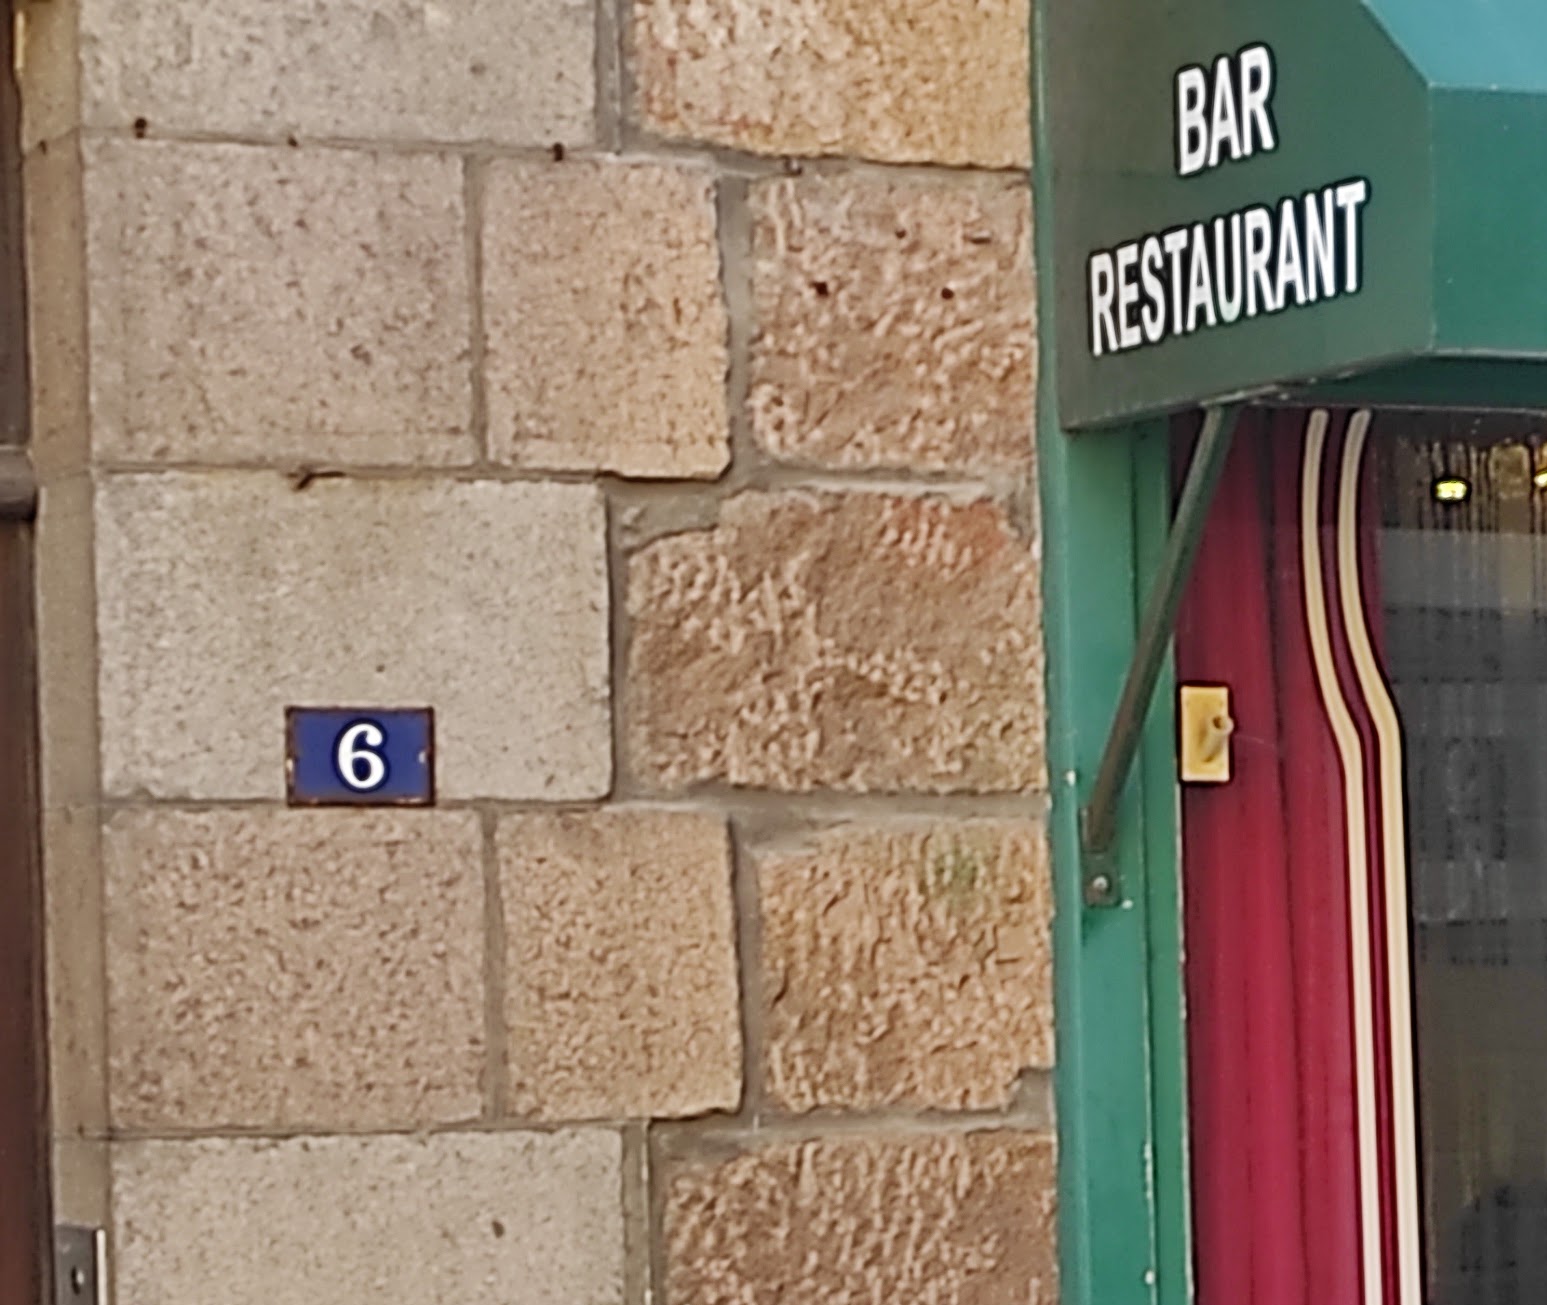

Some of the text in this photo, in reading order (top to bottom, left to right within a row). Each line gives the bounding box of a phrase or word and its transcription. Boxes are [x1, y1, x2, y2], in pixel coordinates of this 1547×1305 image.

[1176, 46, 1274, 176] BAR
[1090, 180, 1367, 355] RESTAURANT
[338, 724, 386, 789] 6
